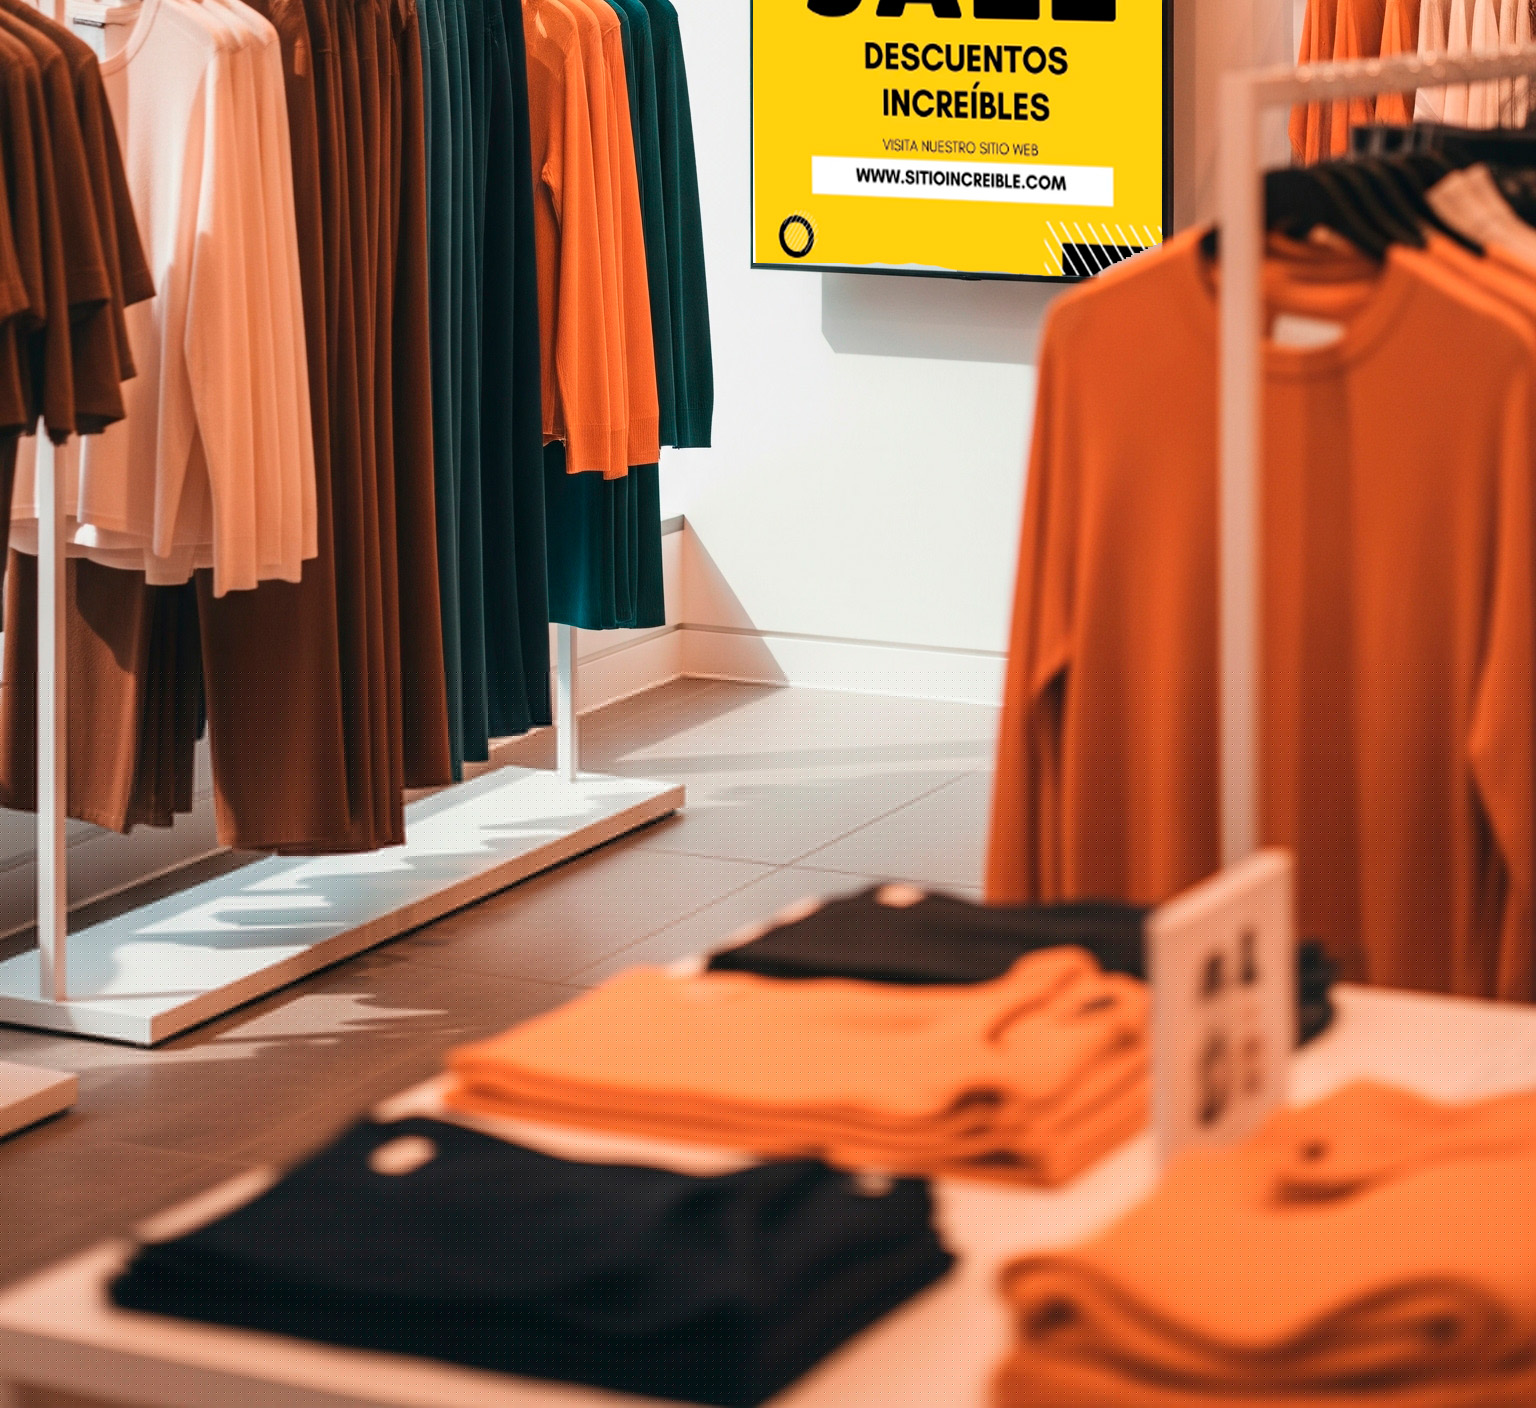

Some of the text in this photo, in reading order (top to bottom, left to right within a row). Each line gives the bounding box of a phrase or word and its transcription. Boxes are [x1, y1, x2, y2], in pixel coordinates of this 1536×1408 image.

[864, 42, 1068, 75] DESCUENTOS
[882, 81, 1050, 122] INCREÍBLES
[882, 138, 1039, 157] VISITA NUESTRO SITIO WEB
[856, 167, 1067, 191] WWW.SITIOINCREIBLE.COM
